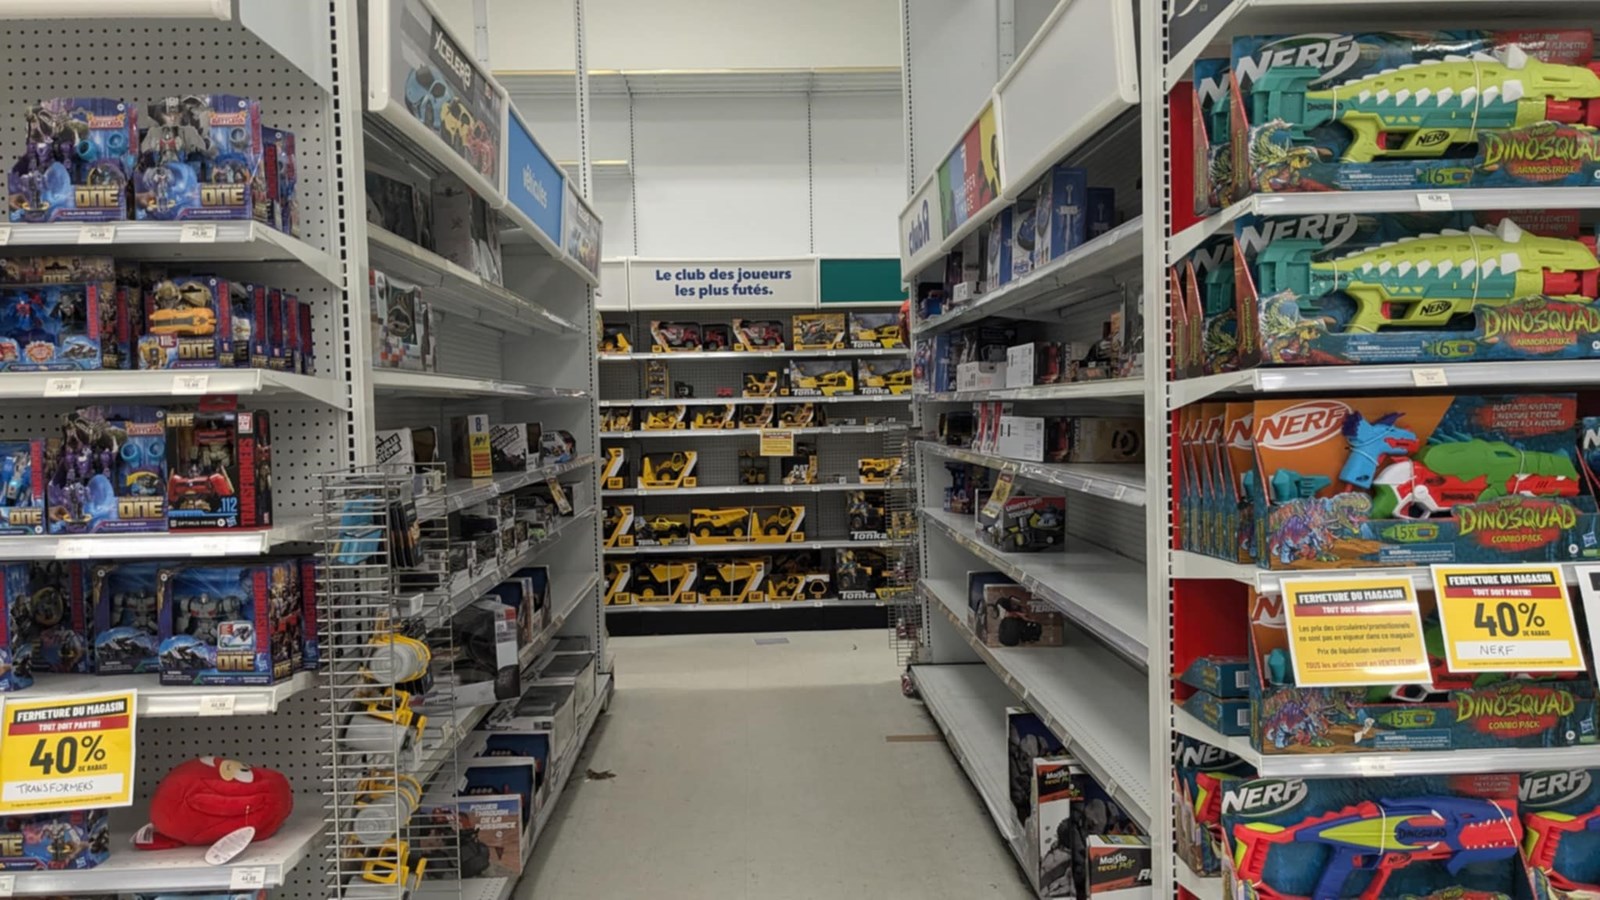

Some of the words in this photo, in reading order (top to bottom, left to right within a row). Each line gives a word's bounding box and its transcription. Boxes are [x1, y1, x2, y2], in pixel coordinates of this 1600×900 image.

[1233, 35, 1354, 89] NERF
[1416, 130, 1449, 146] NERF
[75, 186, 120, 208] ONE
[201, 186, 245, 208] ONE
[1240, 213, 1352, 253] NERF
[655, 269, 672, 281] Le
[675, 268, 706, 281] club
[708, 268, 735, 281] des
[737, 268, 792, 283] joueurs
[675, 284, 695, 296] les
[698, 284, 729, 299] plus
[732, 283, 774, 296] futés.
[1419, 301, 1452, 316] NERF
[178, 341, 215, 360] ONE
[851, 340, 881, 349] Tonka
[791, 388, 822, 397] Tonka
[859, 387, 890, 395] Tonka
[1256, 404, 1349, 442] NERF
[238, 437, 256, 526] TRANSFORMERS
[119, 499, 163, 518] ONE
[220, 497, 238, 512] 112
[9, 510, 42, 525] ONE
[1459, 504, 1576, 535] DINOSQUAD
[850, 531, 887, 540] Tonka
[1492, 535, 1520, 543] COMBO
[1521, 534, 1543, 542] PACK
[1448, 575, 1499, 586] FERMETURE
[1500, 575, 1512, 584] DU
[1513, 573, 1552, 583] MAGASIN
[838, 590, 876, 600] Tonka
[1298, 592, 1350, 604] FERMETURE
[1350, 591, 1362, 601] DU
[1363, 588, 1403, 600] MAGASIN
[1322, 606, 1339, 614] TOUT
[1474, 602, 1545, 637] 40%
[1479, 644, 1516, 656] NERF
[217, 653, 254, 671] ONE
[16, 706, 71, 723] FERMETURE
[72, 705, 86, 717] DU
[86, 700, 125, 716] MAGASIN
[1456, 691, 1575, 722] DINOSQUAD
[38, 722, 57, 732] TOUT
[57, 721, 73, 731] DOIT
[1488, 721, 1517, 730] COMBO
[1518, 720, 1540, 728] PACK
[29, 734, 106, 775] 40%
[16, 780, 94, 794] TRANSFORMERS
[1221, 778, 1304, 815] NERF
